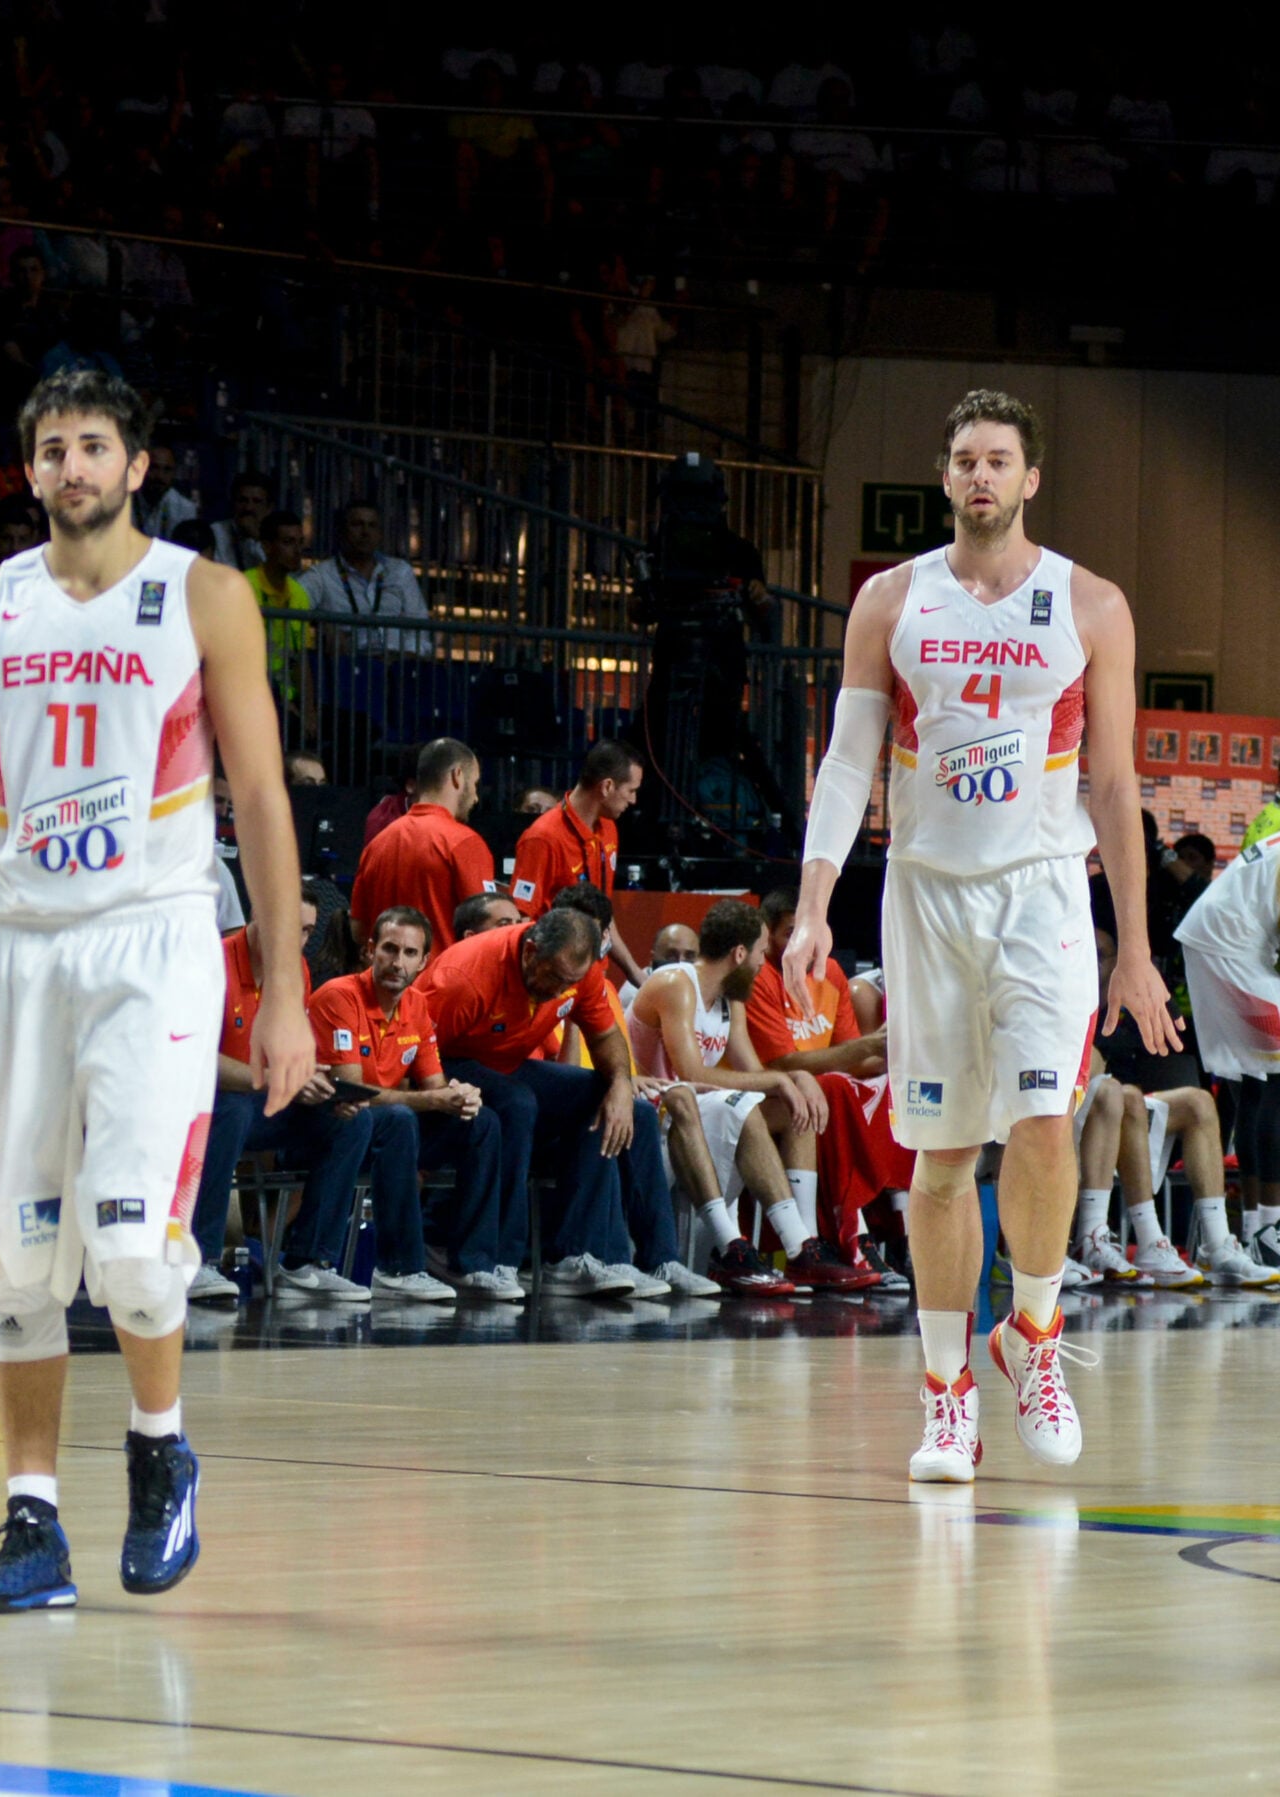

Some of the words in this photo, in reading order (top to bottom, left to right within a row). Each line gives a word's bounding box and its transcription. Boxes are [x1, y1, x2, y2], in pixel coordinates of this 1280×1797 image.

[1, 646, 154, 690] ESPAÑA
[919, 638, 1047, 668] ESPAÑA
[959, 673, 1001, 719] 4
[45, 703, 97, 768] 11
[935, 756, 966, 782] San
[965, 738, 1019, 767] Miguel
[949, 766, 1015, 806] 0,0
[16, 813, 55, 849] San
[55, 786, 124, 827] Miguel
[34, 823, 119, 876] 0,0
[907, 1105, 942, 1118] endesa
[21, 1231, 57, 1248] endes
